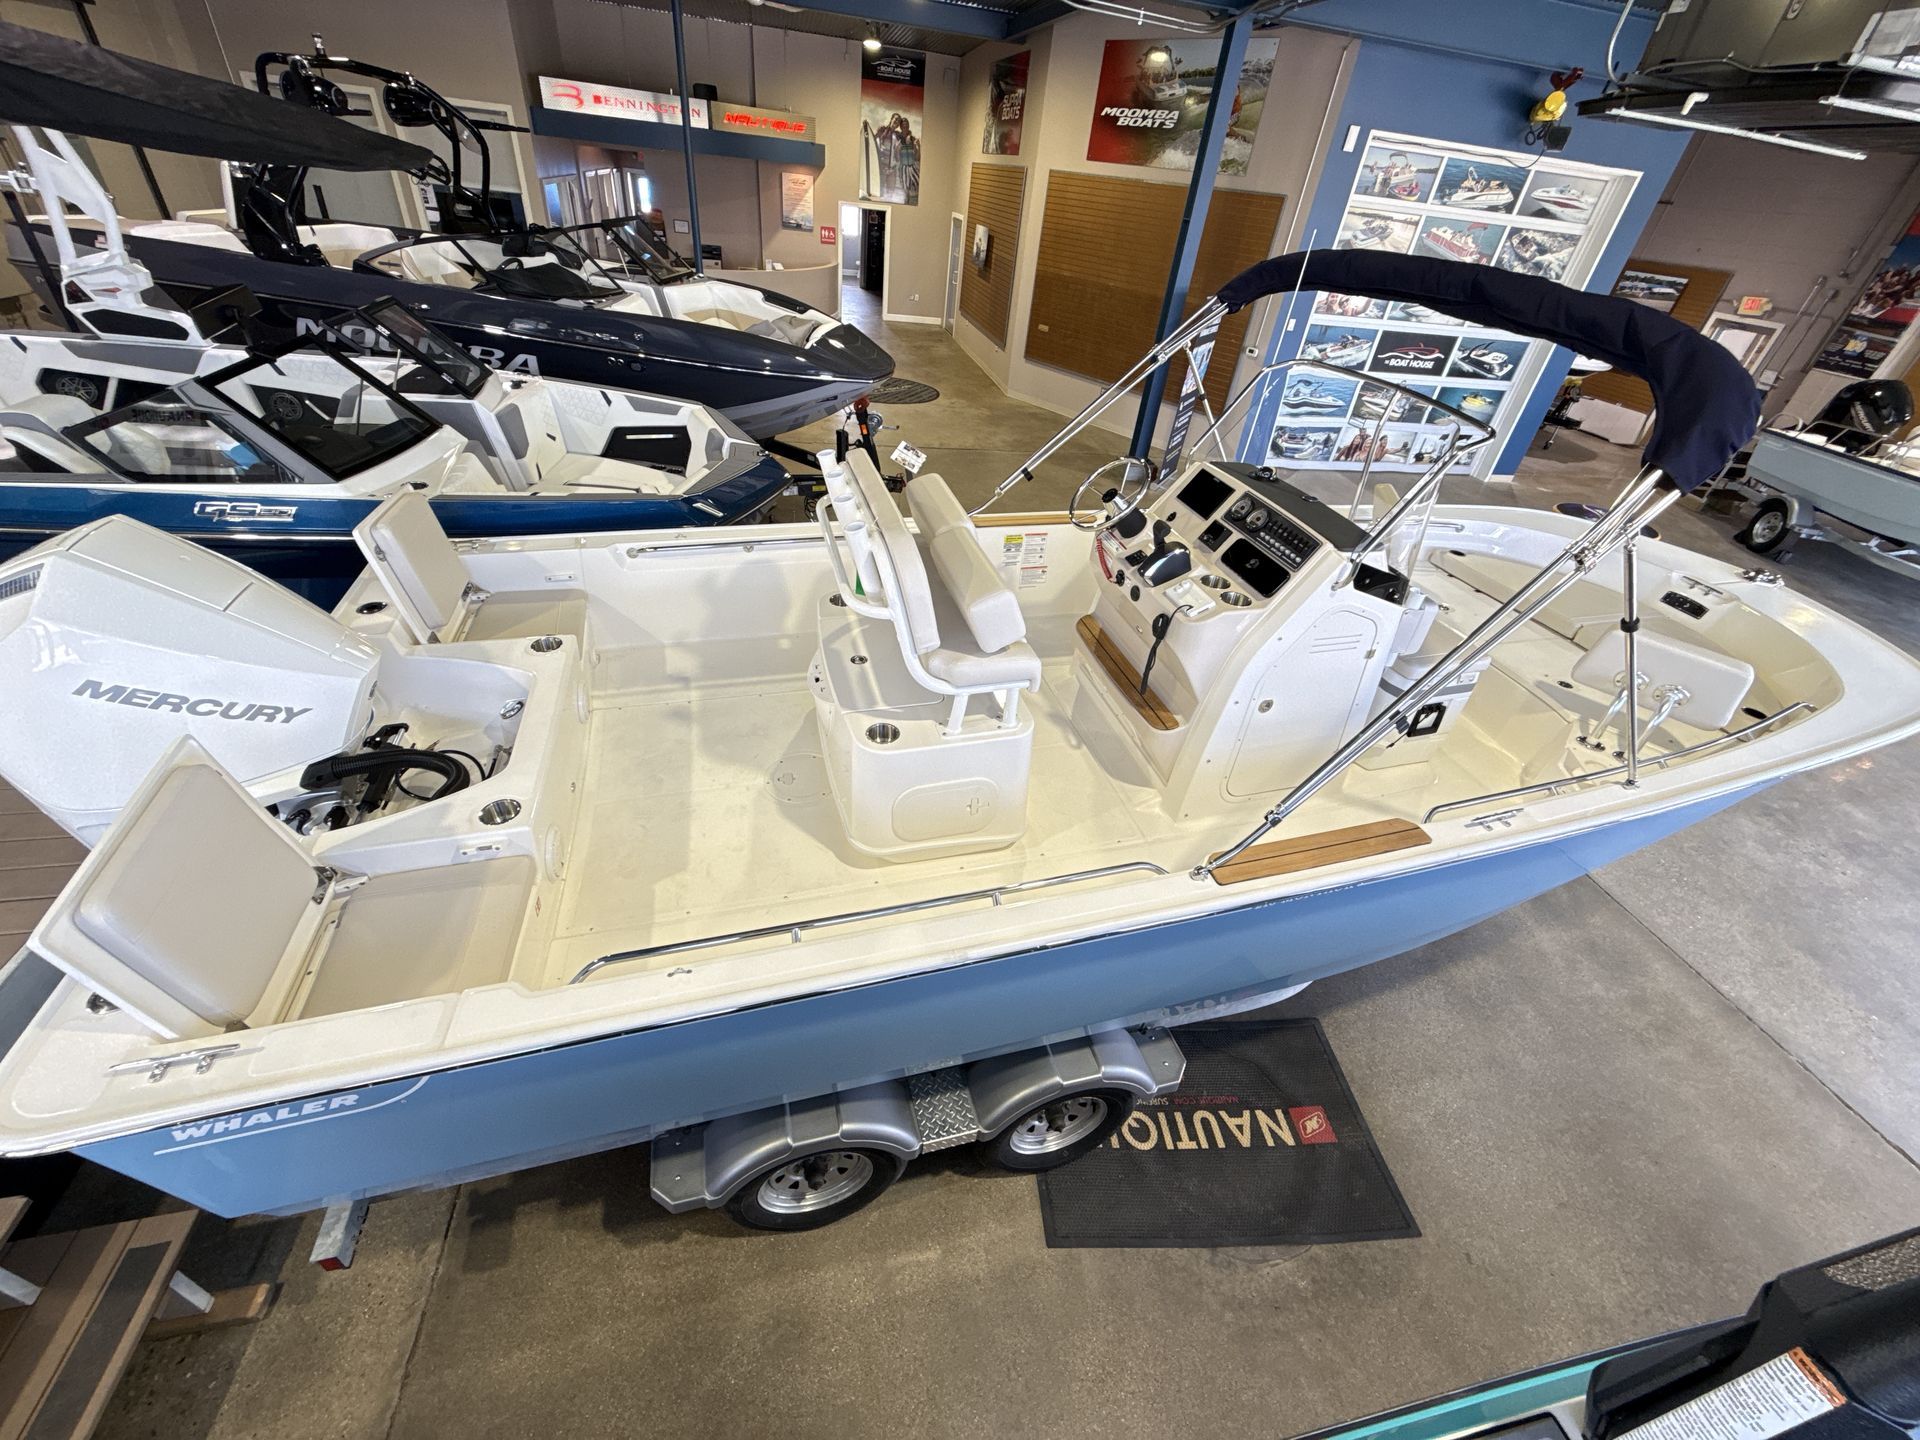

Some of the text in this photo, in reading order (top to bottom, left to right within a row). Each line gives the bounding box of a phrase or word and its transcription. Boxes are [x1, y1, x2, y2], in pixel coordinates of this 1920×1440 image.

[592, 94, 701, 118] BENNINGTN
[1100, 106, 1180, 120] MOOMBA
[1116, 117, 1178, 129] BOATS
[1388, 358, 1411, 367] BOAT
[1408, 359, 1435, 369] HOUSE
[71, 679, 313, 724] MERCURY
[170, 1094, 360, 1142] WHALER
[1097, 1108, 1296, 1151] NAUTIQ
